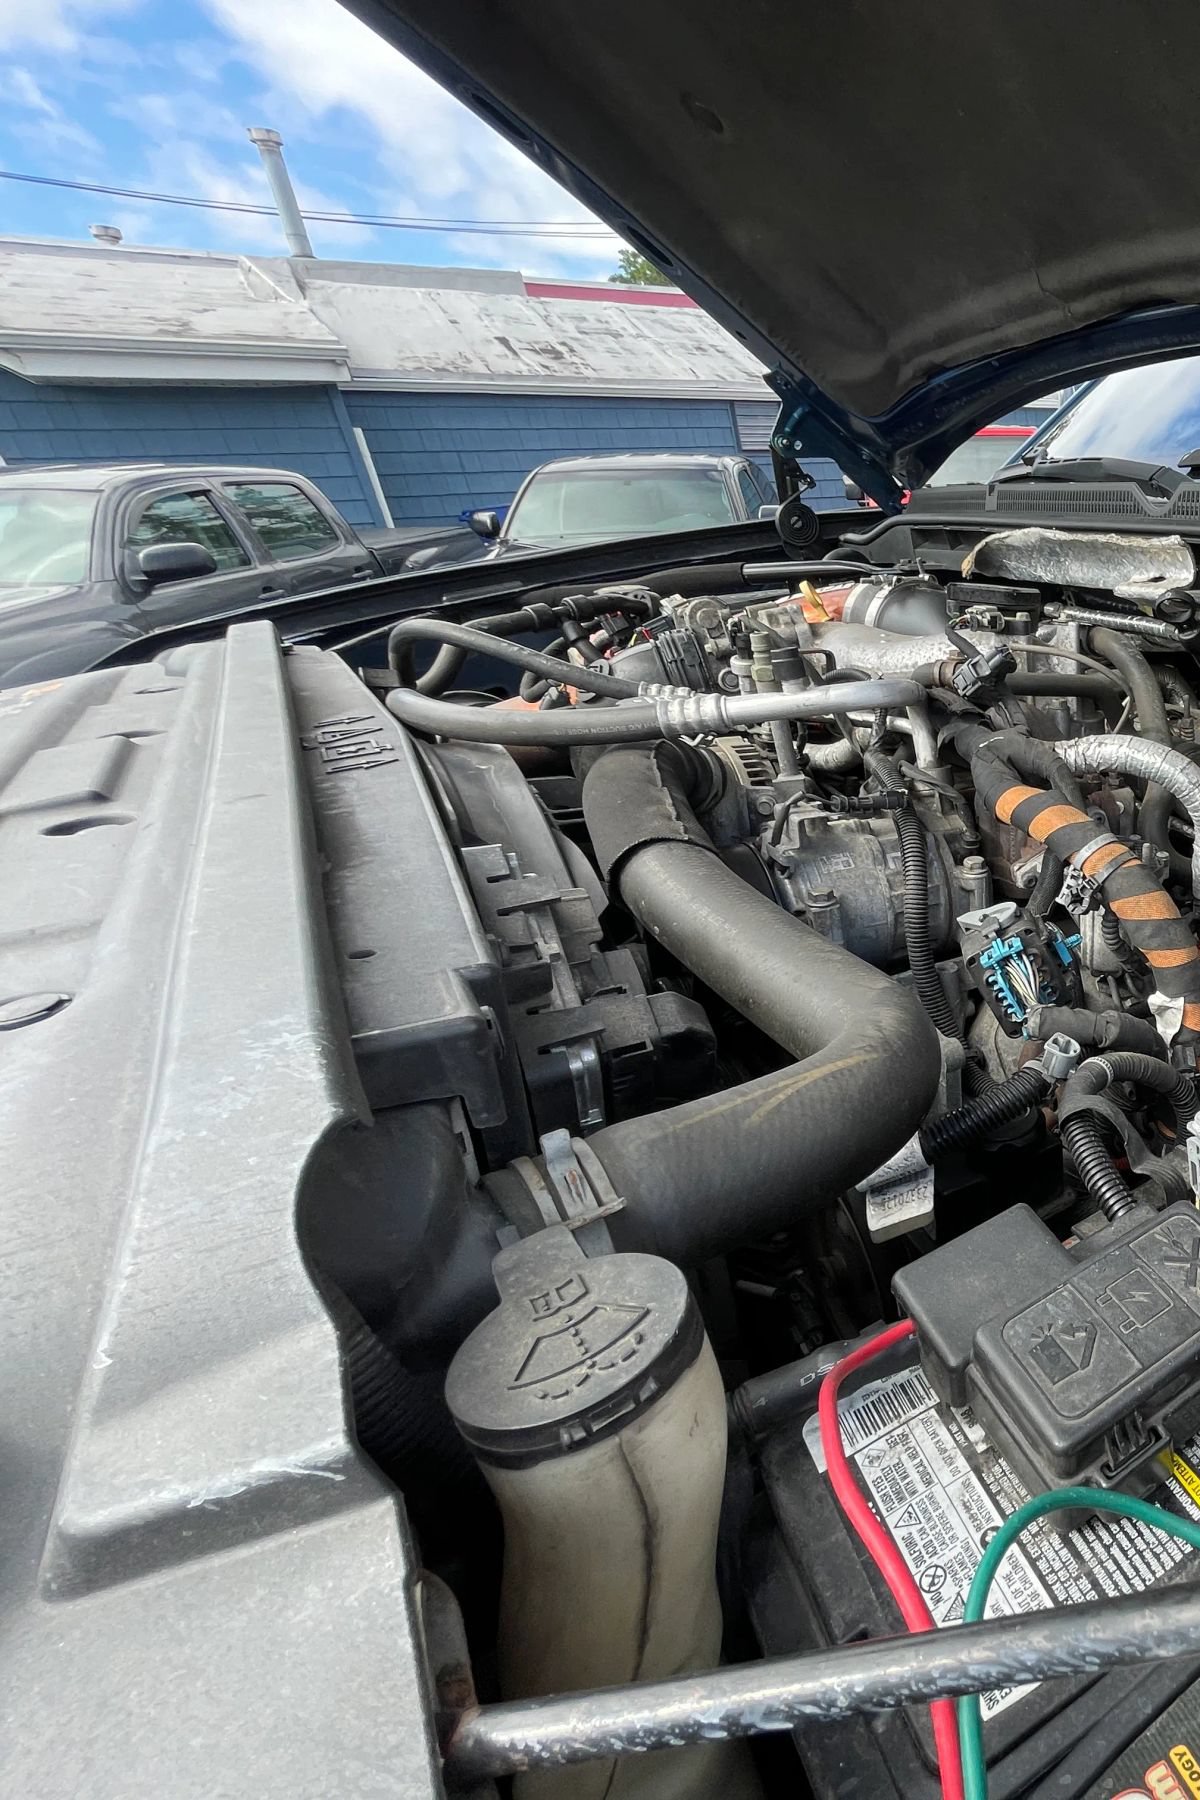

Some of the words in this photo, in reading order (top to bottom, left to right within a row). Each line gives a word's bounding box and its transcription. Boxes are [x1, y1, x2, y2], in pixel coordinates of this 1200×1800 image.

[885, 1434, 898, 1448] GET
[933, 1438, 948, 1455] OPEN
[904, 1444, 920, 1461] HELP
[942, 1453, 955, 1467] NOT
[912, 1458, 934, 1487] MEDICAL
[948, 1465, 961, 1477] DO
[990, 1463, 1004, 1478] FOR
[1171, 1459, 1196, 1485] ATTEM
[871, 1475, 887, 1493] EYES
[879, 1464, 908, 1504] IMMEDIATELY
[902, 1479, 918, 1497] WITH
[879, 1490, 897, 1512] FLUSH
[914, 1497, 938, 1531] BLINDNESS
[935, 1509, 954, 1534] SEVERE
[916, 1525, 929, 1540] CAN
[931, 1528, 949, 1551] CAUSE
[947, 1532, 959, 1544] OR
[1114, 1531, 1132, 1550] cause
[1134, 1519, 1159, 1548] California
[1149, 1523, 1171, 1544] HAND
[900, 1531, 927, 1569] SULFURIC
[921, 1539, 939, 1559] ACID
[1018, 1528, 1042, 1558] EXPLOSI
[1067, 1528, 1094, 1561] WARNING
[1089, 1539, 1109, 1562] related
[1132, 1536, 1147, 1551] also
[1163, 1539, 1185, 1562] WASH
[1172, 1534, 1194, 1553] AFTE
[1057, 1547, 1081, 1576] FOLLOW
[1102, 1558, 1117, 1573] and
[1129, 1554, 1155, 1585] California
[1140, 1548, 1165, 1578] Batteries
[1156, 1551, 1175, 1570] State
[1002, 1570, 1017, 1588] THE
[1044, 1571, 1058, 1584] OF
[1055, 1567, 1070, 1581] OR
[1091, 1564, 1120, 1600] POSITION
[1110, 1569, 1133, 1596] rminals
[929, 1591, 944, 1606] NO
[1010, 1585, 1024, 1599] OF
[1026, 1588, 1040, 1602] OF
[1050, 1580, 1069, 1601] RISK
